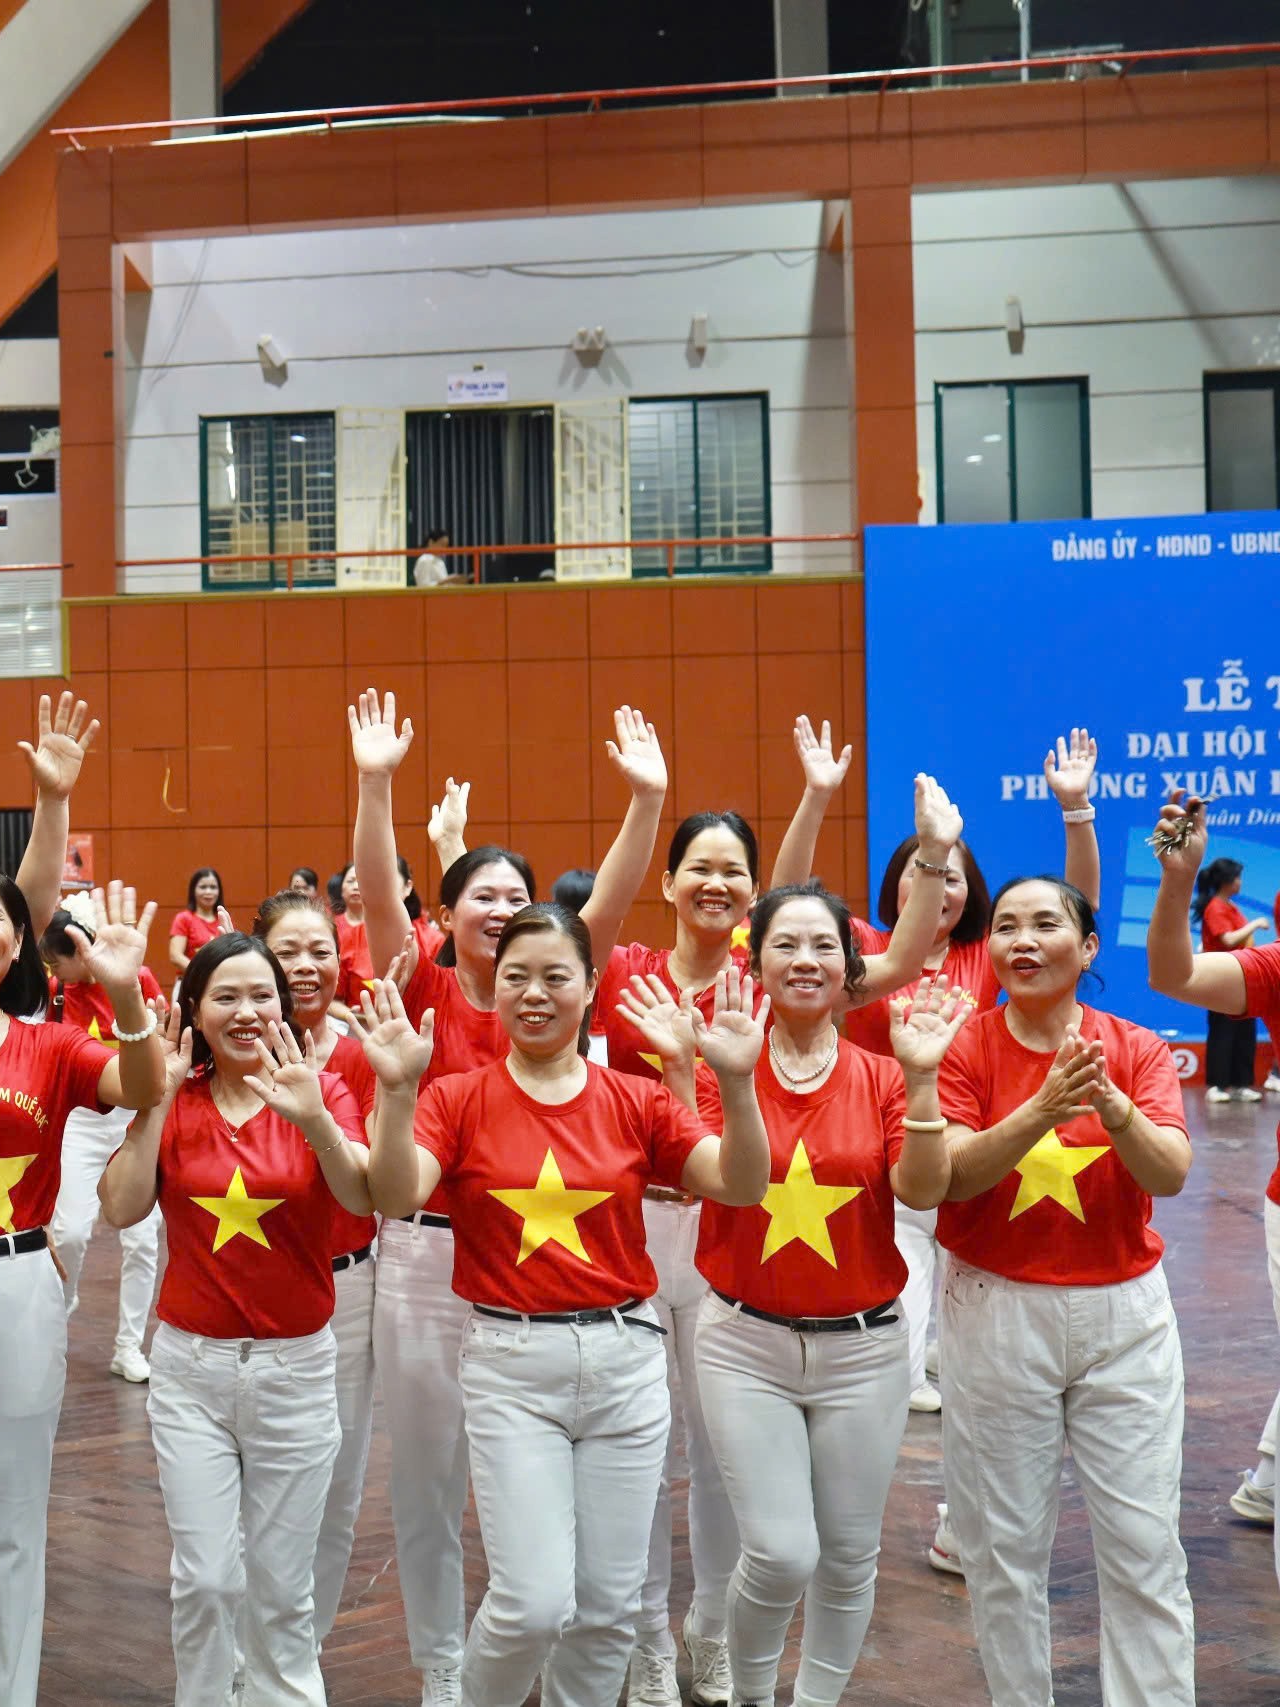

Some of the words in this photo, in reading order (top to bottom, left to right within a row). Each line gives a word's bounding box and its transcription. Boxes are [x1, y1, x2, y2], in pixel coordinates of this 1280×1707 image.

[1052, 532, 1107, 561] ĐẢNG
[1112, 529, 1137, 559] ỦY
[1156, 534, 1212, 558] HĐND
[1183, 658, 1252, 712] LỄ
[1128, 731, 1190, 761] ĐẠI
[1202, 724, 1266, 761] HỘI
[1001, 772, 1147, 800] PHNG
[1161, 765, 1257, 798] XUÂN
[1206, 808, 1241, 826] uân
[14, 1090, 39, 1116] QUÊ
